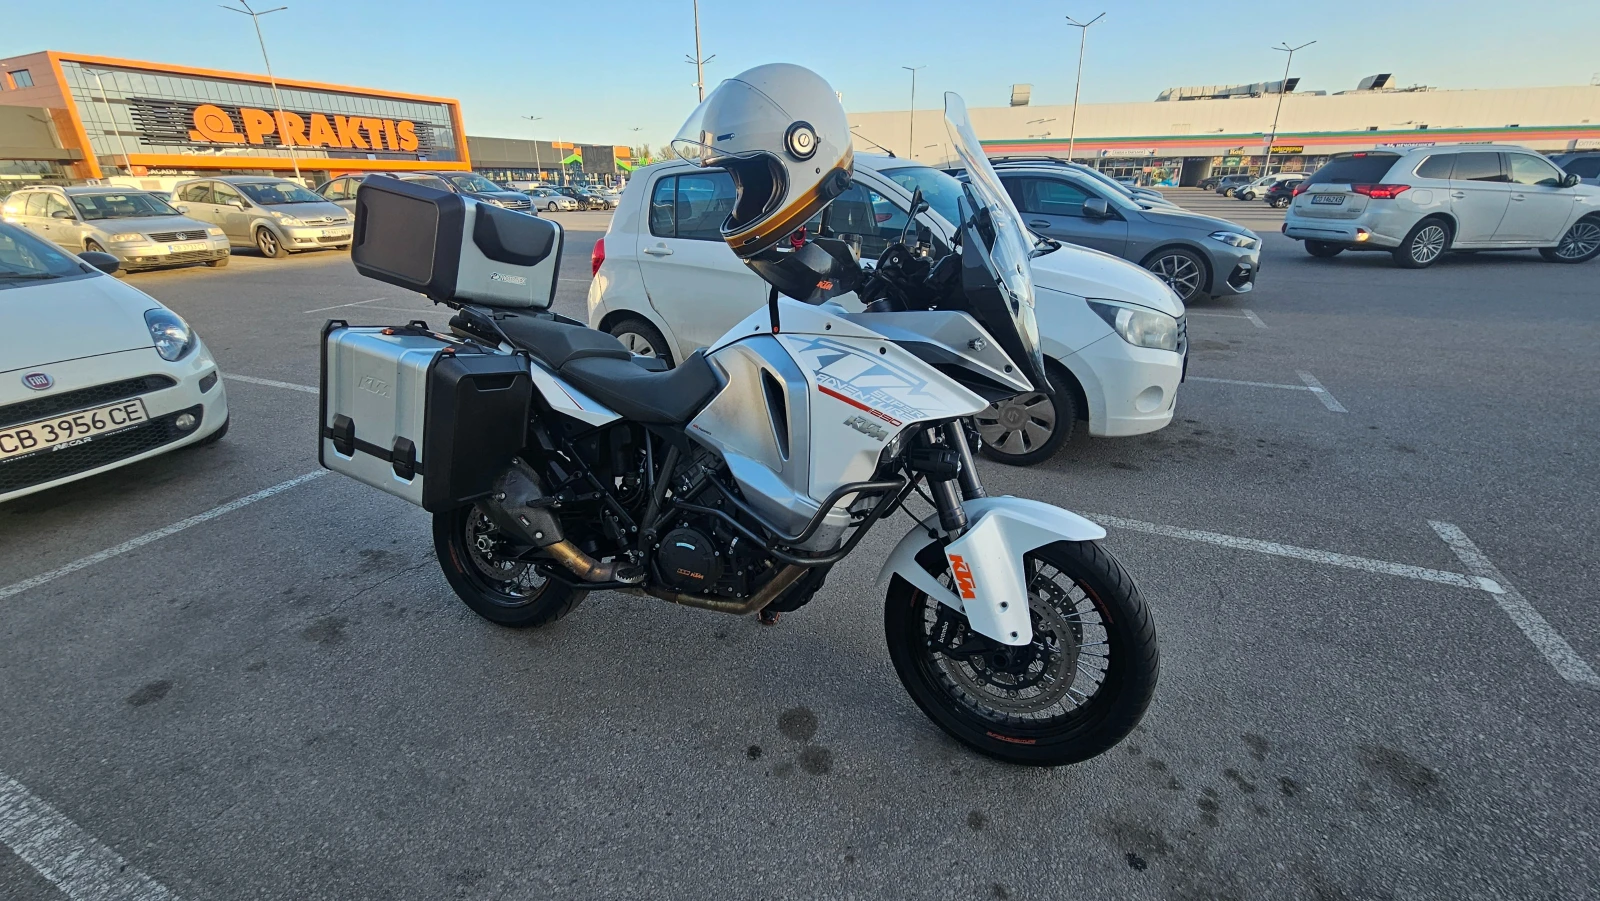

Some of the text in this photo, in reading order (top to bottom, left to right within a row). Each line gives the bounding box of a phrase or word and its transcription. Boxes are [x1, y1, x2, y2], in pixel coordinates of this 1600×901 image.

[240, 107, 419, 152] PRAKTIS
[816, 280, 834, 290] KTM
[28, 375, 48, 386] FIAT
[815, 373, 917, 422] ADVENTURE
[870, 389, 928, 419] SUPER
[0, 428, 38, 454] CB
[41, 411, 107, 443] 3956
[108, 403, 143, 425] CE
[843, 415, 889, 442] KTM
[948, 553, 977, 599] KTM
[938, 621, 949, 644] brembo
